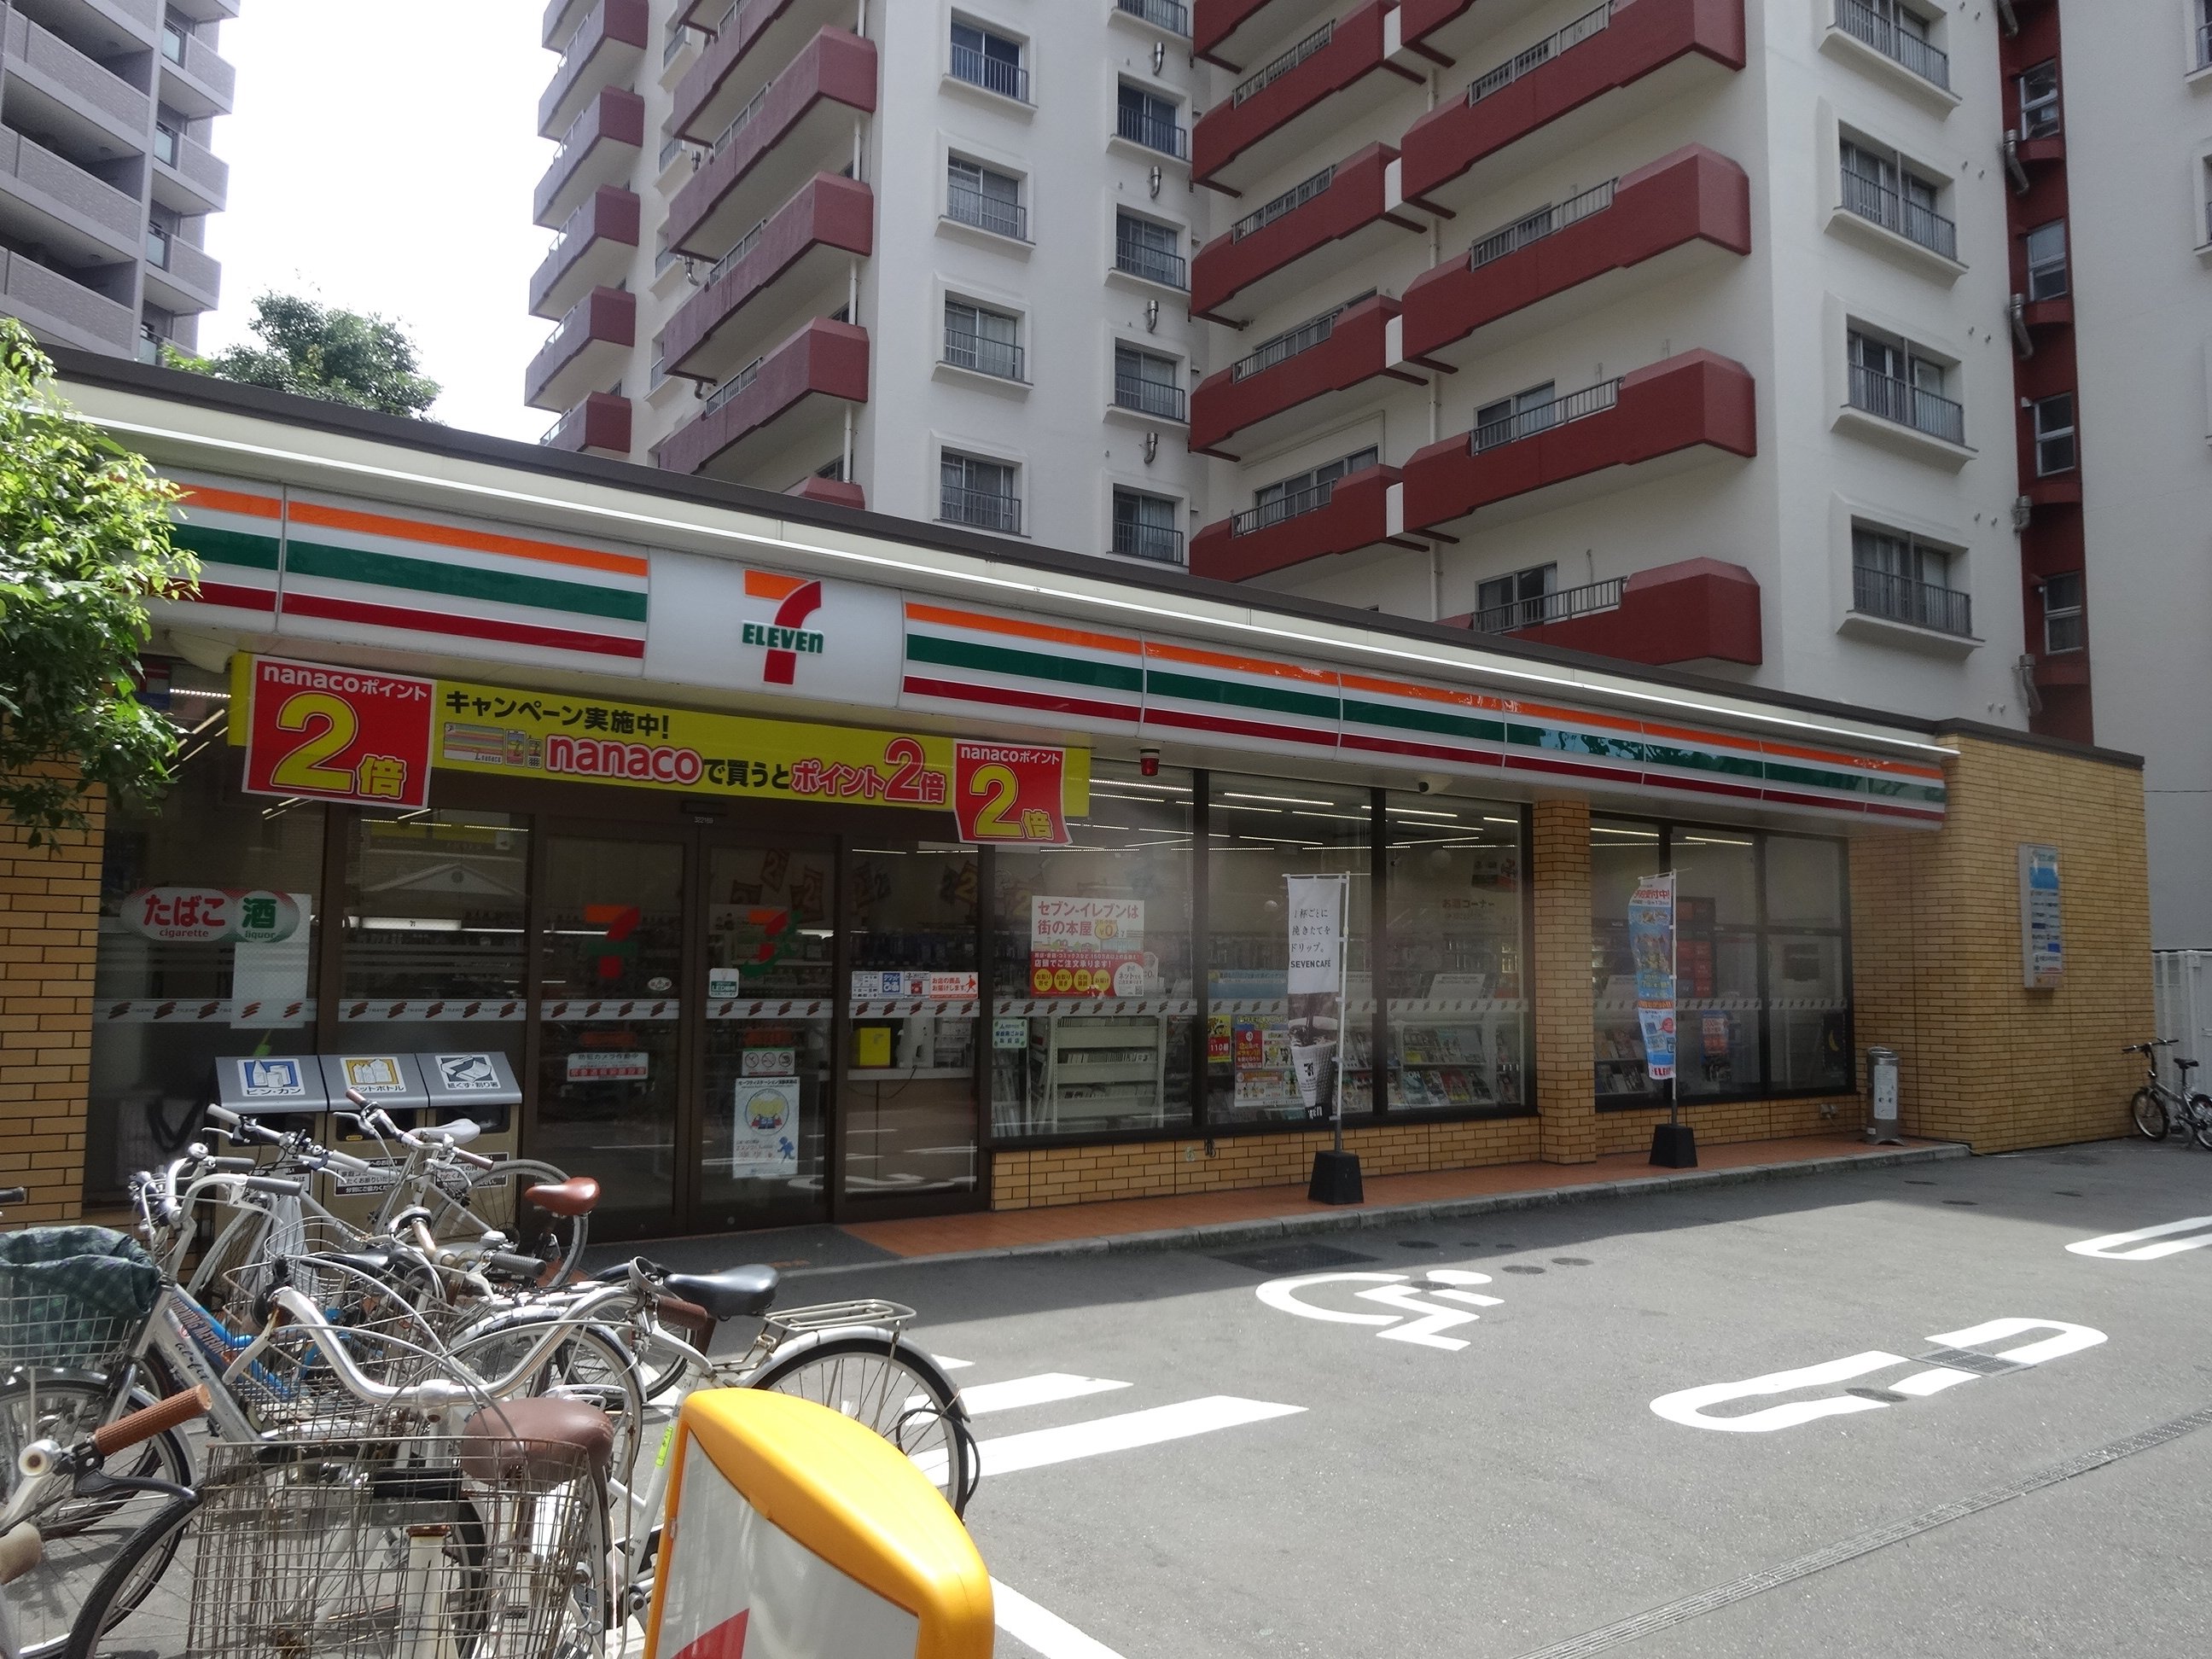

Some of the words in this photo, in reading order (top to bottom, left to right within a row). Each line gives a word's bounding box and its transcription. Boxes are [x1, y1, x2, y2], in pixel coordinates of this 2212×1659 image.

[264, 663, 428, 702] nanacoポイント
[445, 690, 670, 740] キャンペーン実施中!
[270, 691, 408, 800] 2倍
[961, 744, 1060, 766] nanacoポイント
[969, 763, 1054, 841] 2倍
[143, 894, 226, 928] たばこ
[242, 896, 277, 929] 酒
[1038, 900, 1139, 919] セブン-イレブンは
[159, 928, 209, 939] cigarette
[245, 930, 276, 940] liquor
[1038, 919, 1092, 936] 街の本屋
[1290, 960, 1315, 969] SEVEN
